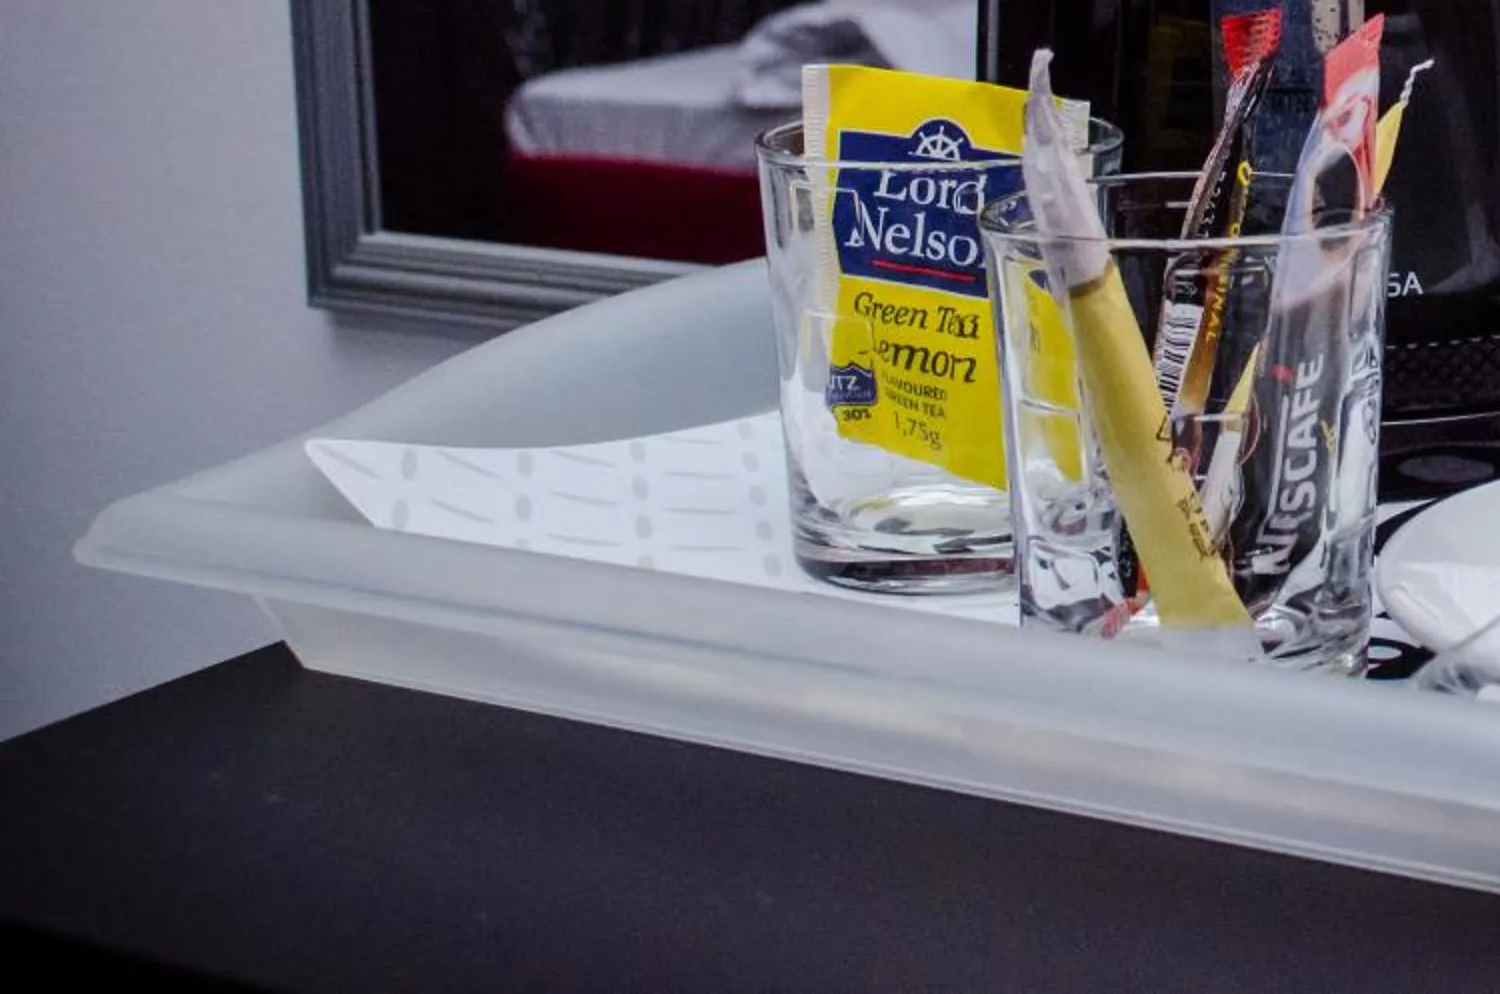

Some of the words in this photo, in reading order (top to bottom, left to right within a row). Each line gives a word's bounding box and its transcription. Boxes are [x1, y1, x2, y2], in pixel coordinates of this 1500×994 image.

[873, 169, 988, 215] Lord
[844, 201, 987, 269] Nelso
[854, 291, 928, 331] Green
[936, 304, 981, 339] Tea
[872, 338, 977, 383] emon
